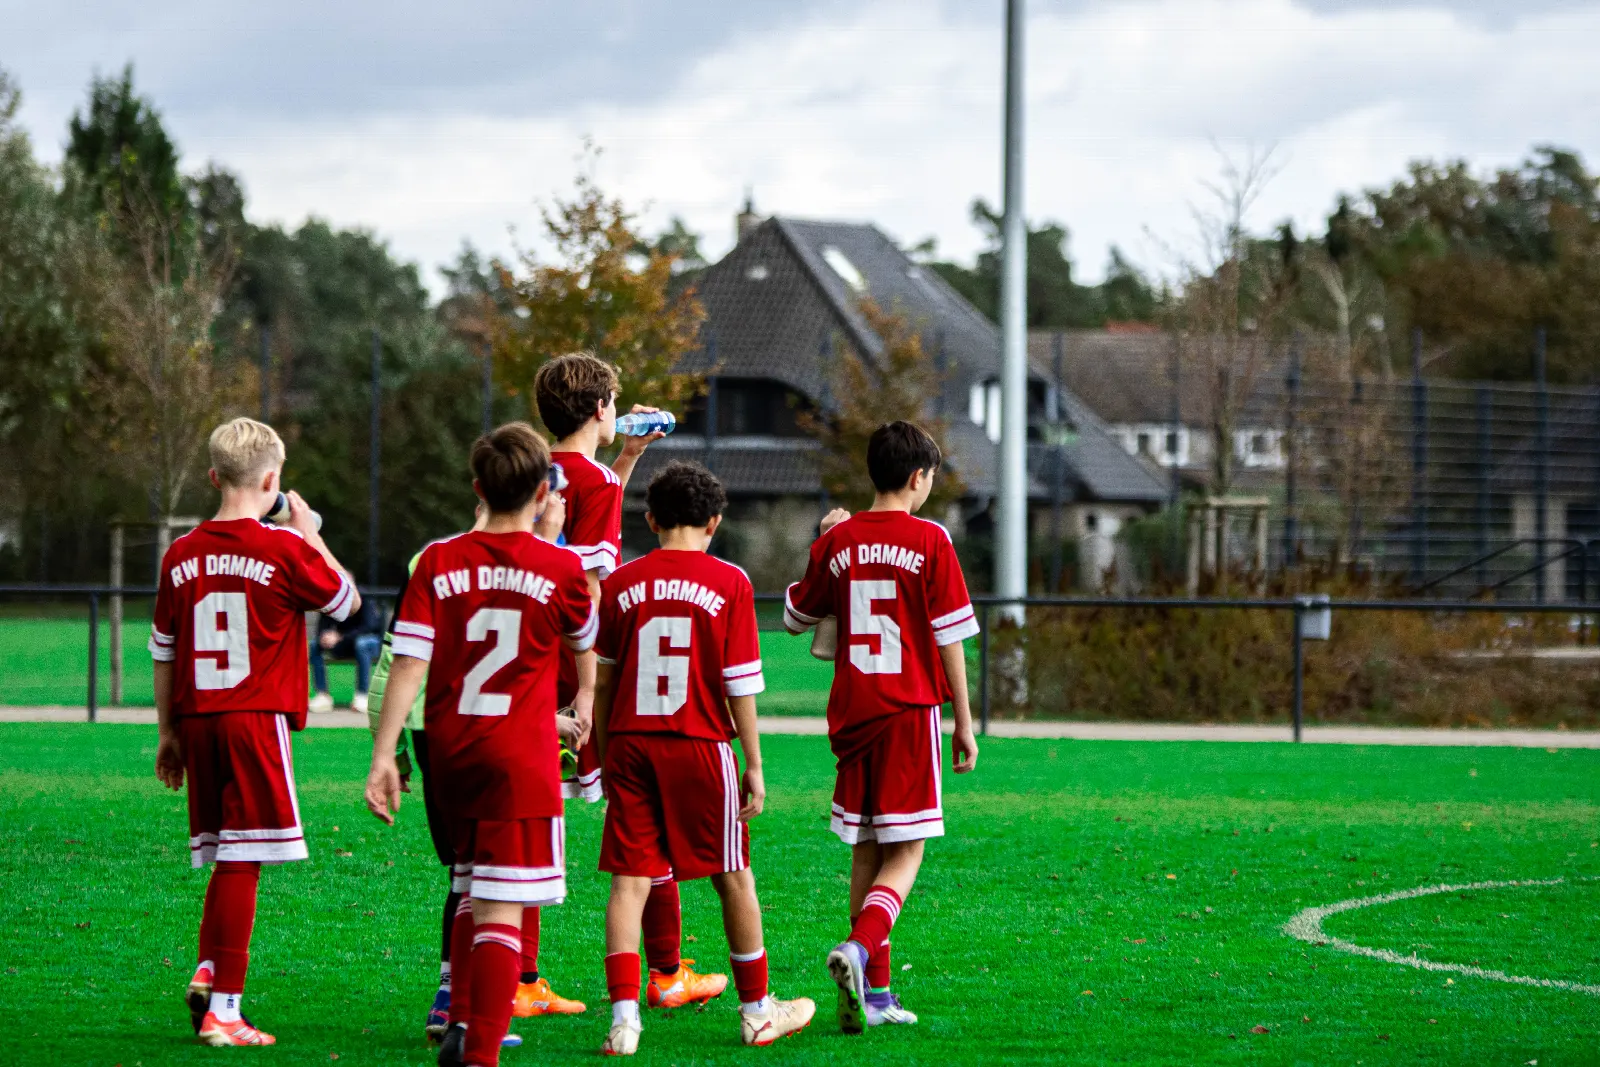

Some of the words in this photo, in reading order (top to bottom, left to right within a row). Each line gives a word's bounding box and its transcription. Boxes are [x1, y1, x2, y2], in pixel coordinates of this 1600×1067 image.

[170, 557, 199, 588] RW
[205, 554, 276, 587] DAMME
[433, 568, 471, 600] RW
[477, 565, 556, 605] DAMME
[829, 546, 851, 578] RW
[857, 543, 925, 575] DAMME
[617, 580, 647, 614] RW
[653, 578, 726, 618] DAMME
[849, 579, 902, 675] 5
[193, 591, 251, 691] 9
[457, 607, 522, 717] 2
[636, 616, 692, 716] 6
